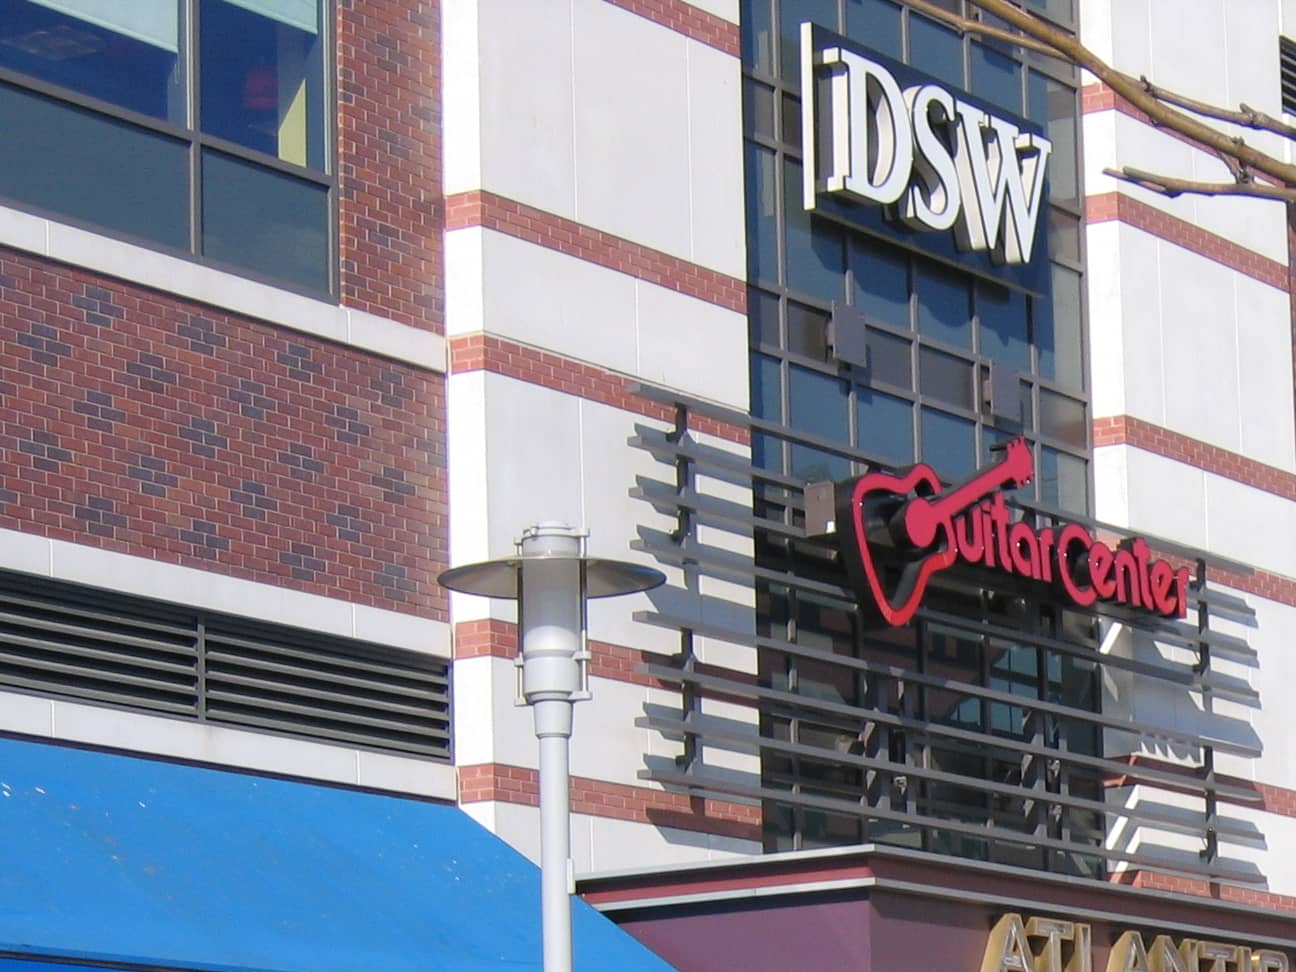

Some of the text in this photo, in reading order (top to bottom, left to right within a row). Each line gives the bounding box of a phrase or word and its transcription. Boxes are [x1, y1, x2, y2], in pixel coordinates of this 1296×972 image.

[819, 46, 1052, 264] DSW
[852, 436, 1190, 626] Guitar Center
